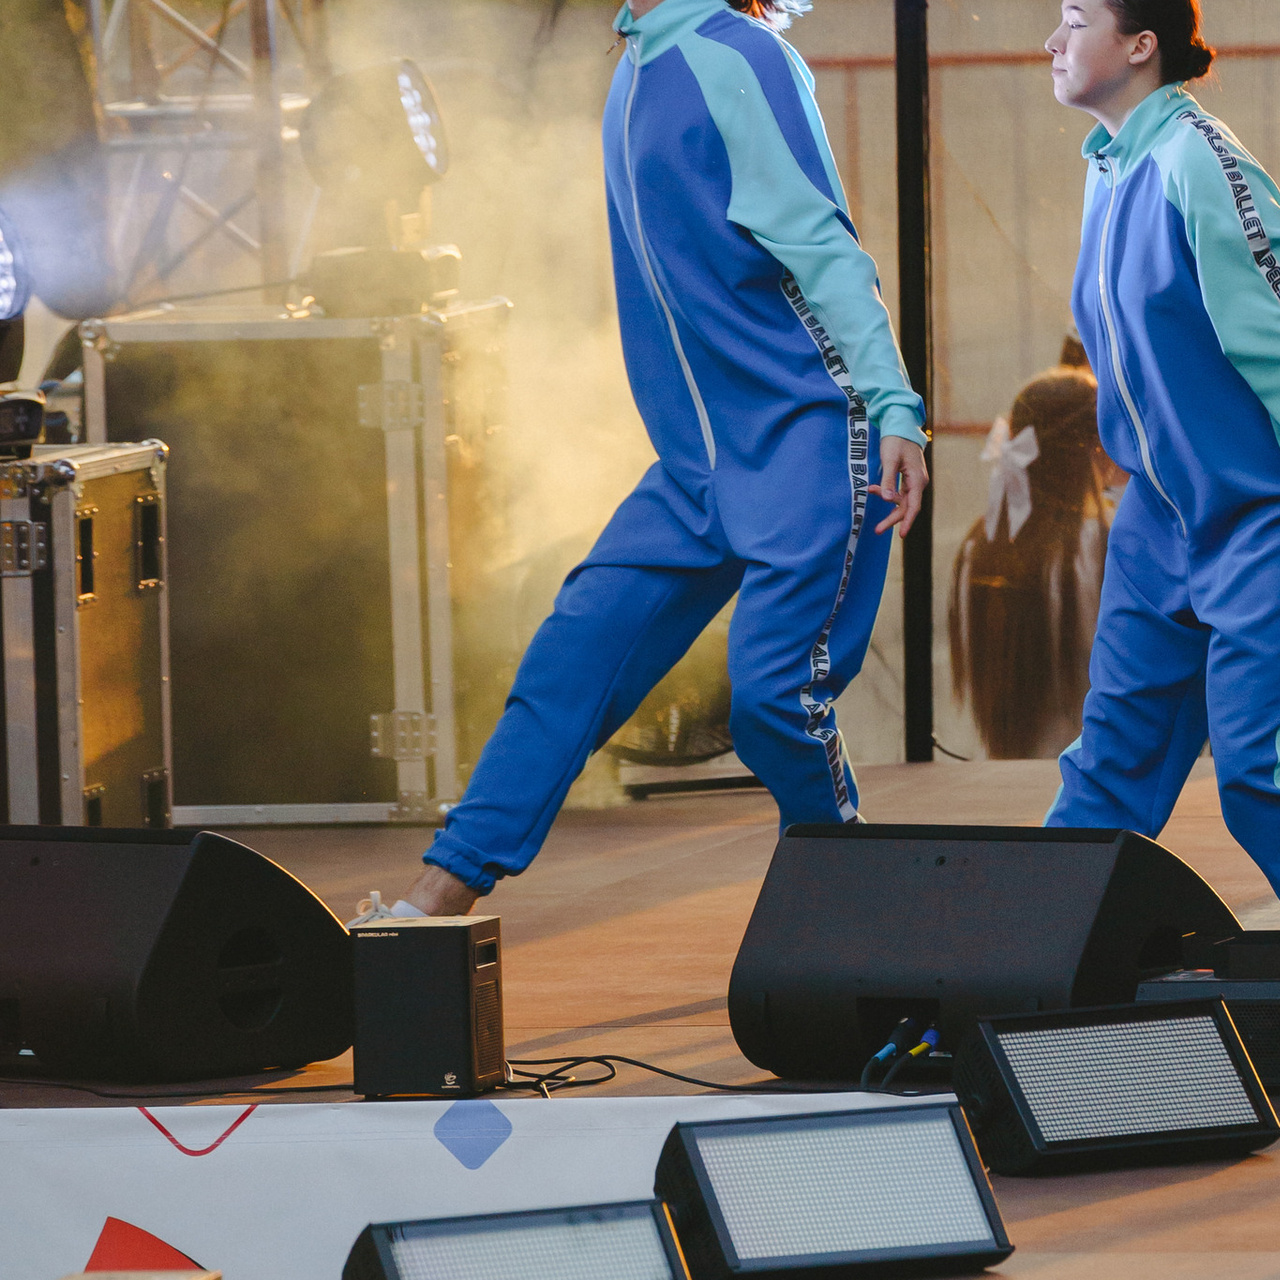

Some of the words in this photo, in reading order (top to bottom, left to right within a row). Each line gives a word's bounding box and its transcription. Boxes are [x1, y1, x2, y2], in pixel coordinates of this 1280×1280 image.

[1226, 170, 1266, 240] BALLET
[804, 315, 850, 377] BALLET
[841, 385, 868, 460] APELSIN
[850, 463, 868, 538] BALLET
